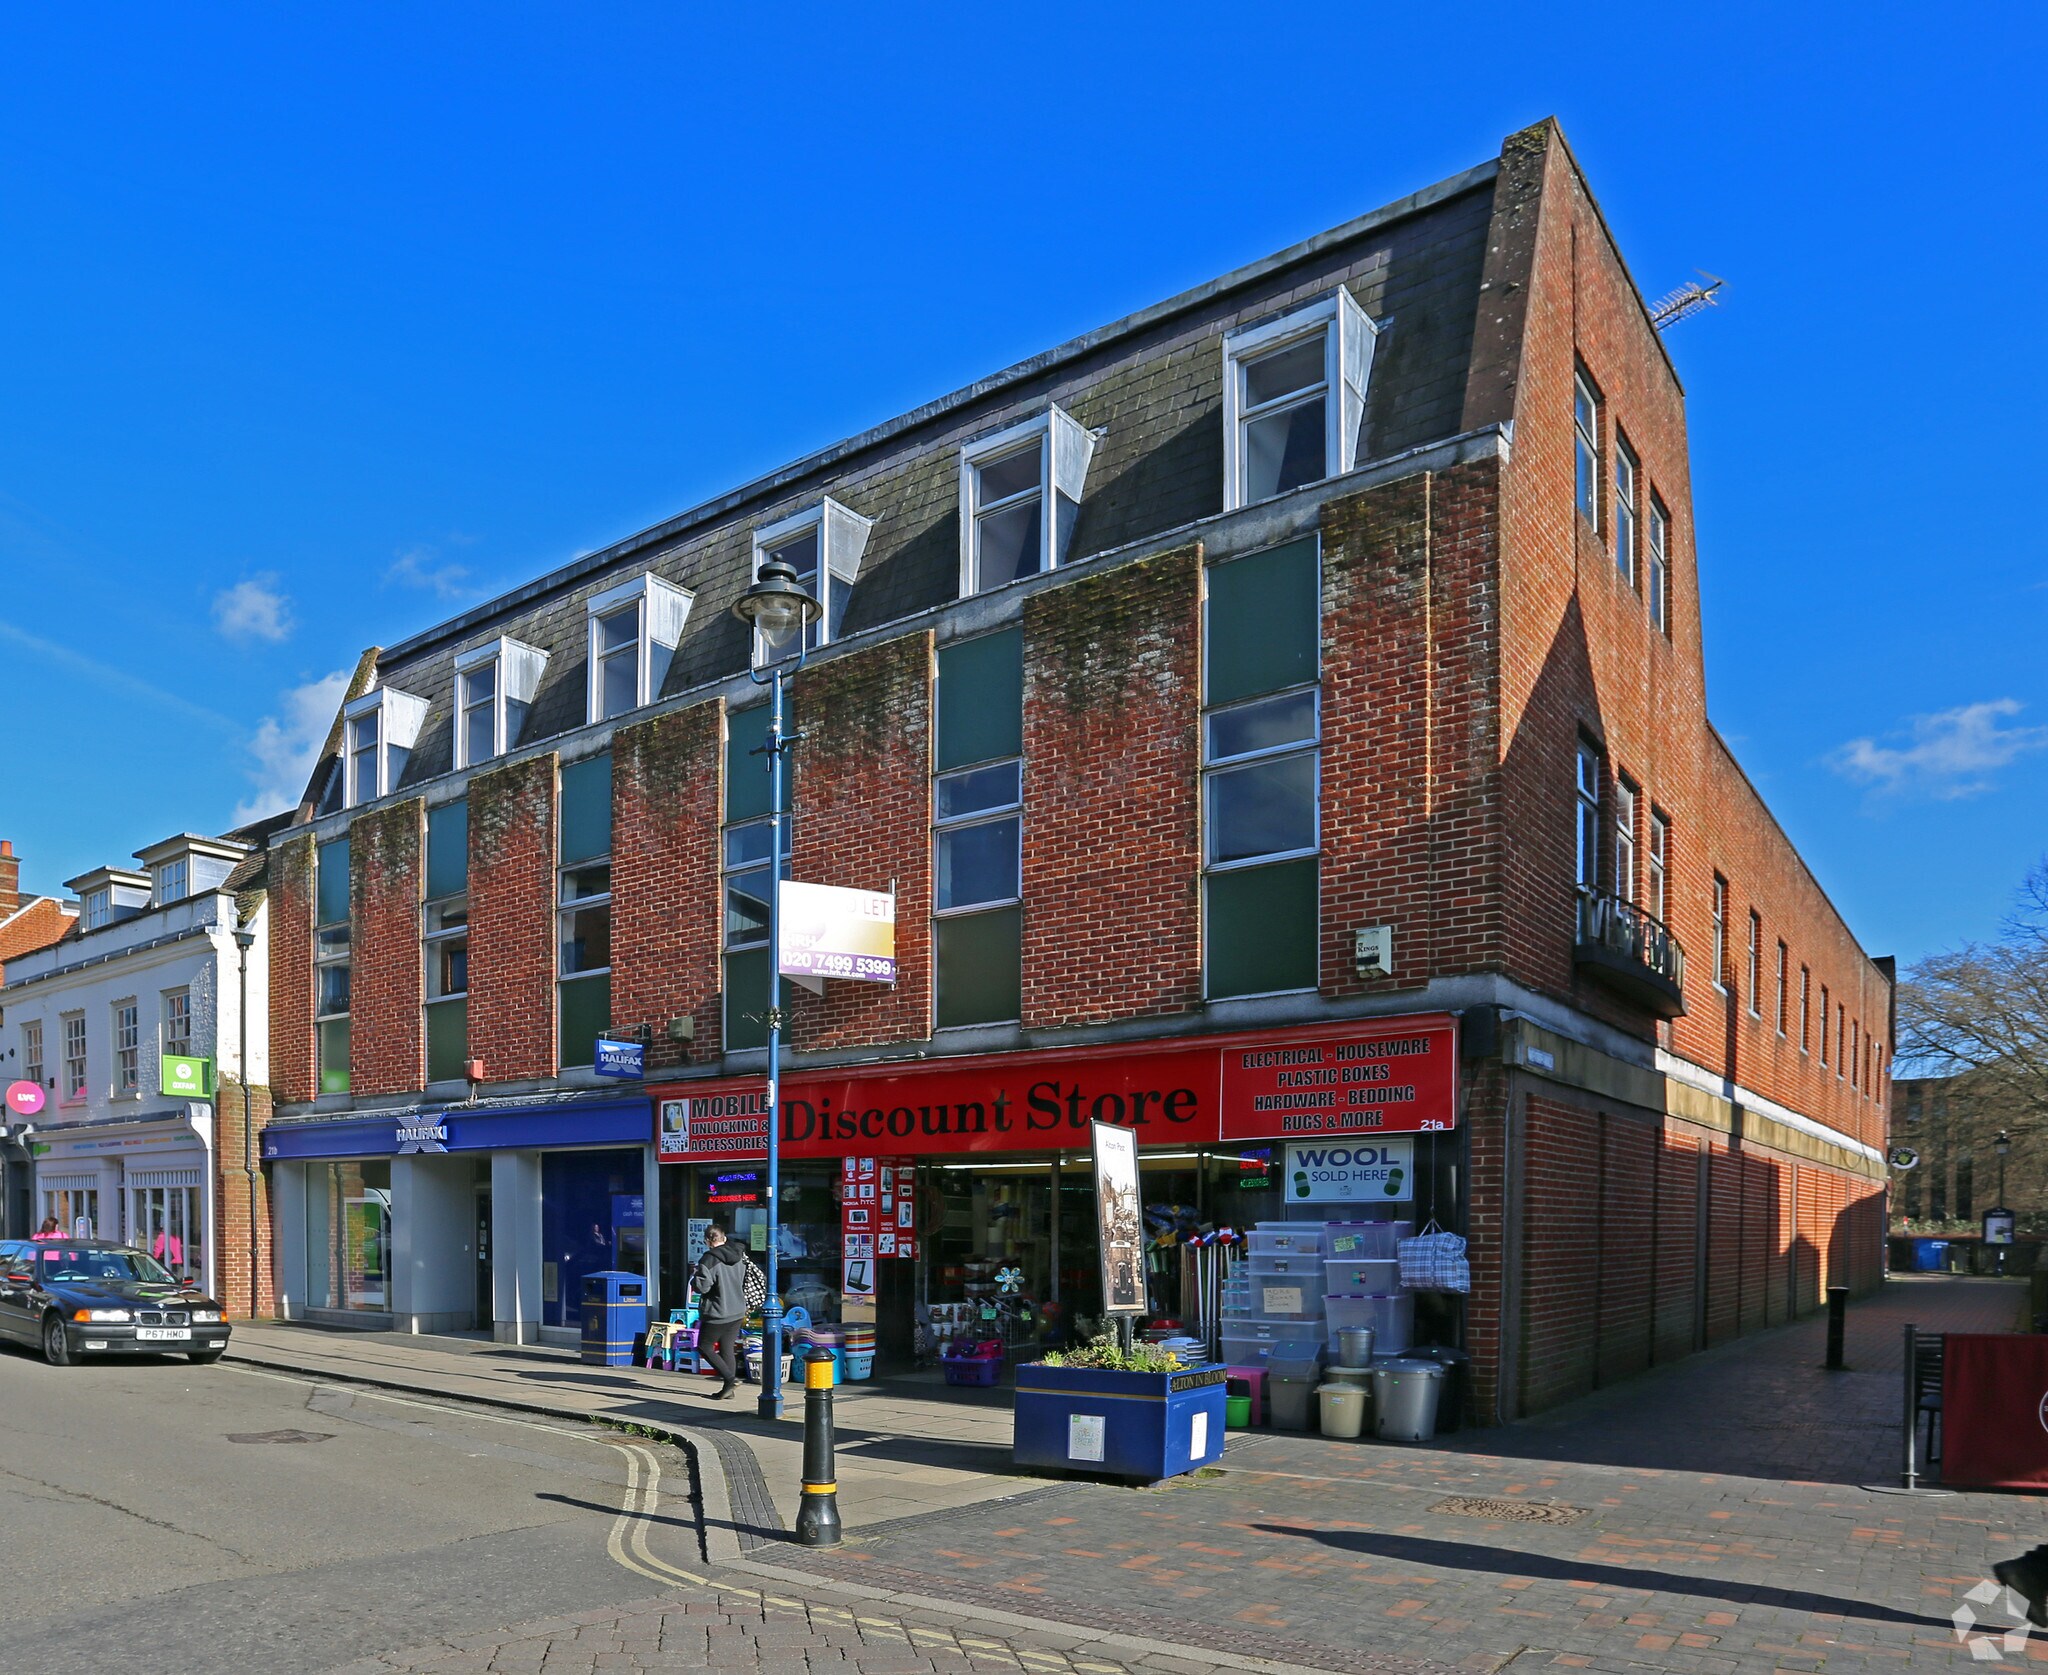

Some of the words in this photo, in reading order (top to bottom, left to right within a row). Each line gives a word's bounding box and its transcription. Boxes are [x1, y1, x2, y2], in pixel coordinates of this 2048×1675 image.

[781, 950, 812, 968] 020
[814, 953, 853, 972] 7499
[856, 957, 891, 975] 5399
[811, 968, 866, 979] www.hrh.uk.com
[600, 1053, 642, 1067] HALIFAX
[1242, 1047, 1324, 1070] ELECTRICAL
[1335, 1037, 1430, 1062] HOUSEWARE
[1277, 1069, 1338, 1088] PLASTIC
[1341, 1063, 1389, 1083] BOXES
[172, 1081, 196, 1090] OXFAM
[691, 1092, 769, 1119] MOBILE
[1254, 1090, 1336, 1111] HARDWARE
[1348, 1084, 1415, 1106] BEDDING
[781, 1090, 1013, 1142] Discount
[1026, 1080, 1198, 1131] Store
[1282, 1114, 1323, 1132] RUGS
[1326, 1113, 1336, 1130] &
[1340, 1109, 1384, 1128] MORE
[396, 1126, 447, 1142] HALIFAX
[691, 1119, 758, 1136] UNLOCKING
[761, 1120, 769, 1132] &
[1420, 1119, 1445, 1131] 21a
[691, 1136, 769, 1152] ACCESSORIES
[1296, 1147, 1401, 1168] WOOL
[1311, 1170, 1349, 1182] SOLD
[1352, 1169, 1388, 1181] HERE
[145, 1330, 164, 1339] P67
[1171, 1375, 1194, 1391] ALTON
[1195, 1373, 1204, 1387] IN
[1204, 1369, 1228, 1385] BLOOM
